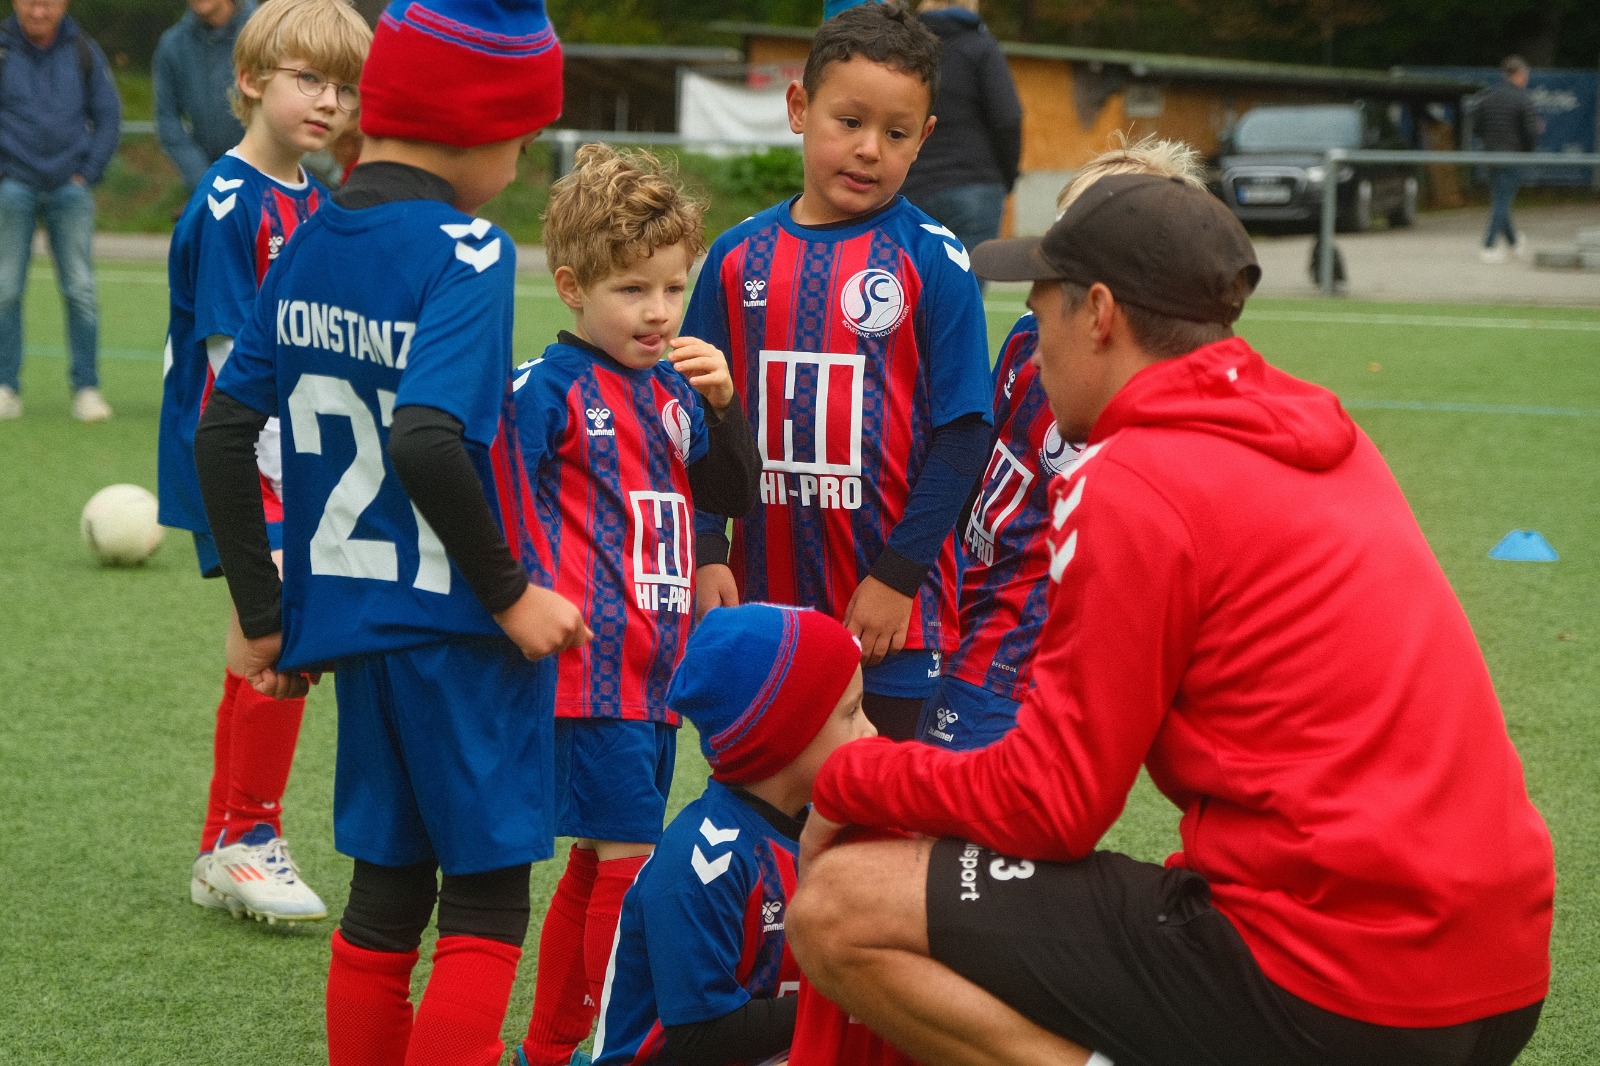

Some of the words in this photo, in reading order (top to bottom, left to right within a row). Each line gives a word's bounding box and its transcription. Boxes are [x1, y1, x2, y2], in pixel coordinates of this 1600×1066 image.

[743, 298, 767, 308] hummel
[586, 427, 615, 437] hummel
[760, 471, 863, 510] HI-PRO
[635, 583, 691, 615] HI-PRO
[989, 851, 1036, 881] 3
